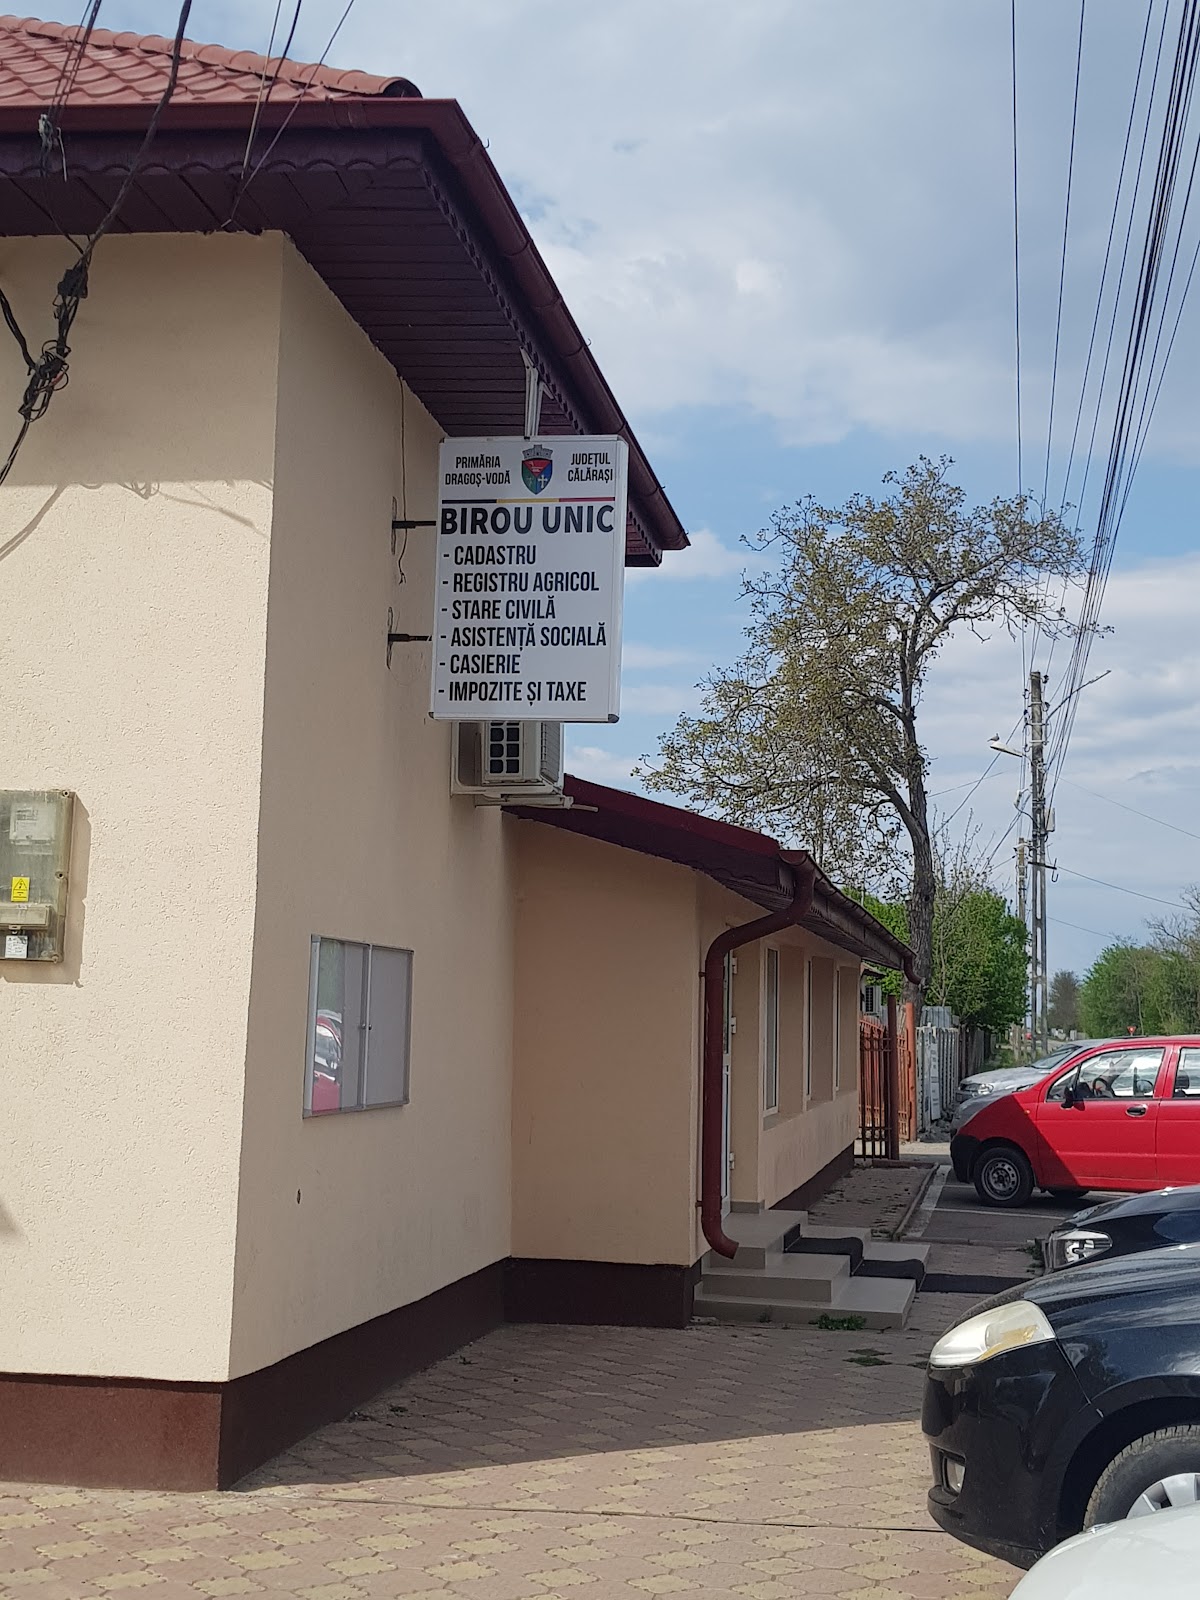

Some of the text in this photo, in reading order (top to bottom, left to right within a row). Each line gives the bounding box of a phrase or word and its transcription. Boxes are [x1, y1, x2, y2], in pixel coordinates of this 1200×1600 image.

[456, 455, 500, 468] PRIMĂRIA
[571, 453, 610, 467] JUDEȚUL
[568, 466, 613, 484] CĂLĂRAȘI
[441, 505, 614, 535] BIROU UNIC
[454, 546, 536, 565] CADASTRU
[453, 572, 528, 592] REGISTRU
[533, 572, 599, 591] AGRICOL
[452, 600, 501, 619] STARE
[506, 596, 555, 619] CIVILĂ
[451, 623, 535, 651] ASISTENȚĂ
[541, 622, 606, 646] SOCIALĂ
[450, 654, 520, 674] CASIERIE
[449, 682, 522, 701] IMPOZITE
[527, 682, 541, 706] ȘI
[547, 682, 586, 701] TAXE
